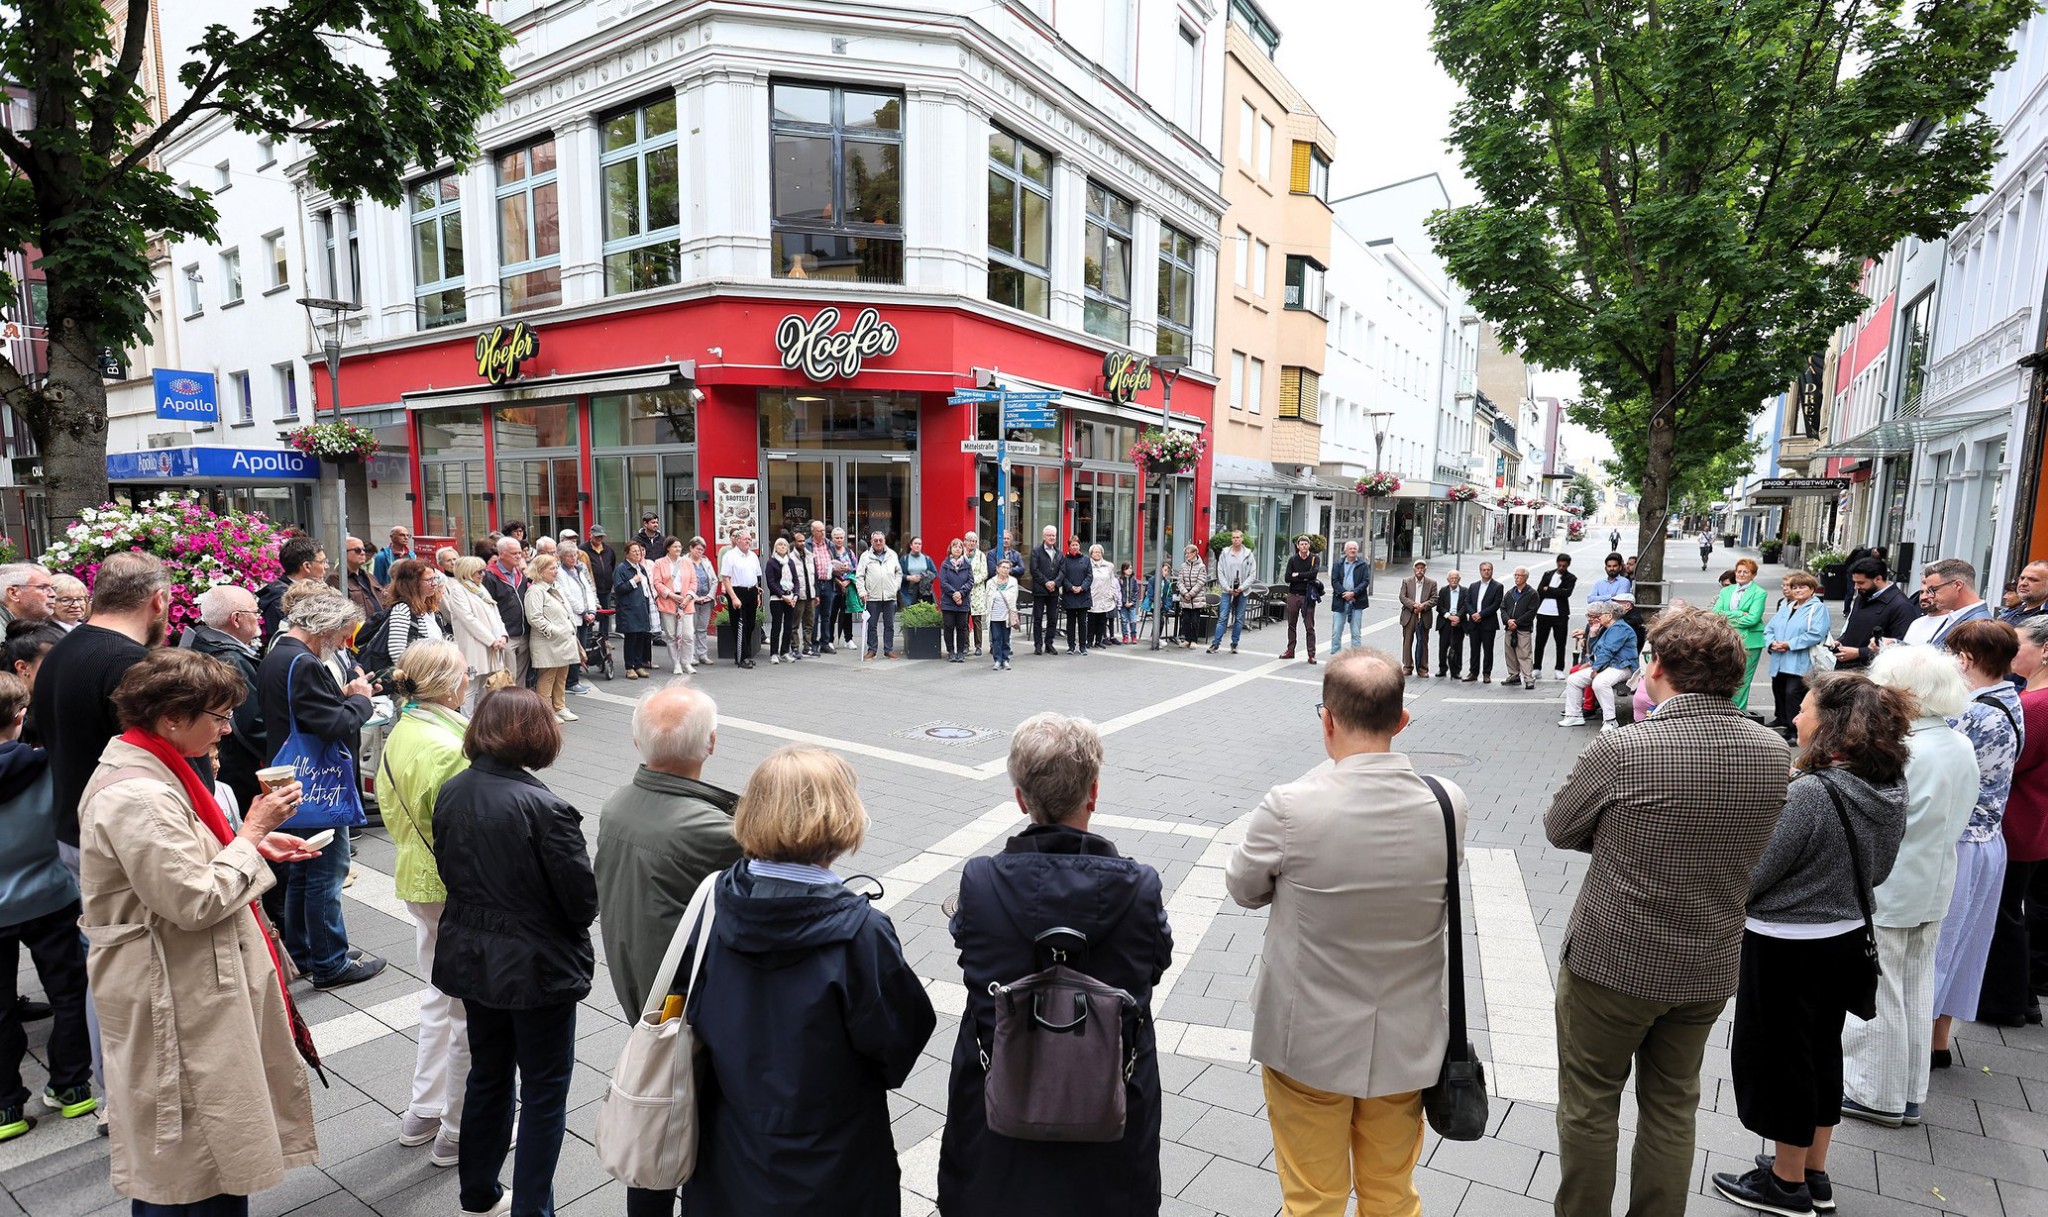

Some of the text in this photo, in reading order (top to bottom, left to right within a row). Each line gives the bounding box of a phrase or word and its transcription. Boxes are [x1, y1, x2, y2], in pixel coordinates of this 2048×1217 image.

[475, 320, 534, 385] Hoefer
[775, 307, 899, 382] Hoefer
[1109, 352, 1152, 404] Hoefer
[163, 397, 214, 413] Apollo
[964, 442, 994, 451] Mittelstraße
[1025, 444, 1038, 453] Straße
[137, 455, 157, 474] Apollo
[232, 452, 304, 474] Apollo
[292, 755, 343, 780] Alles, was
